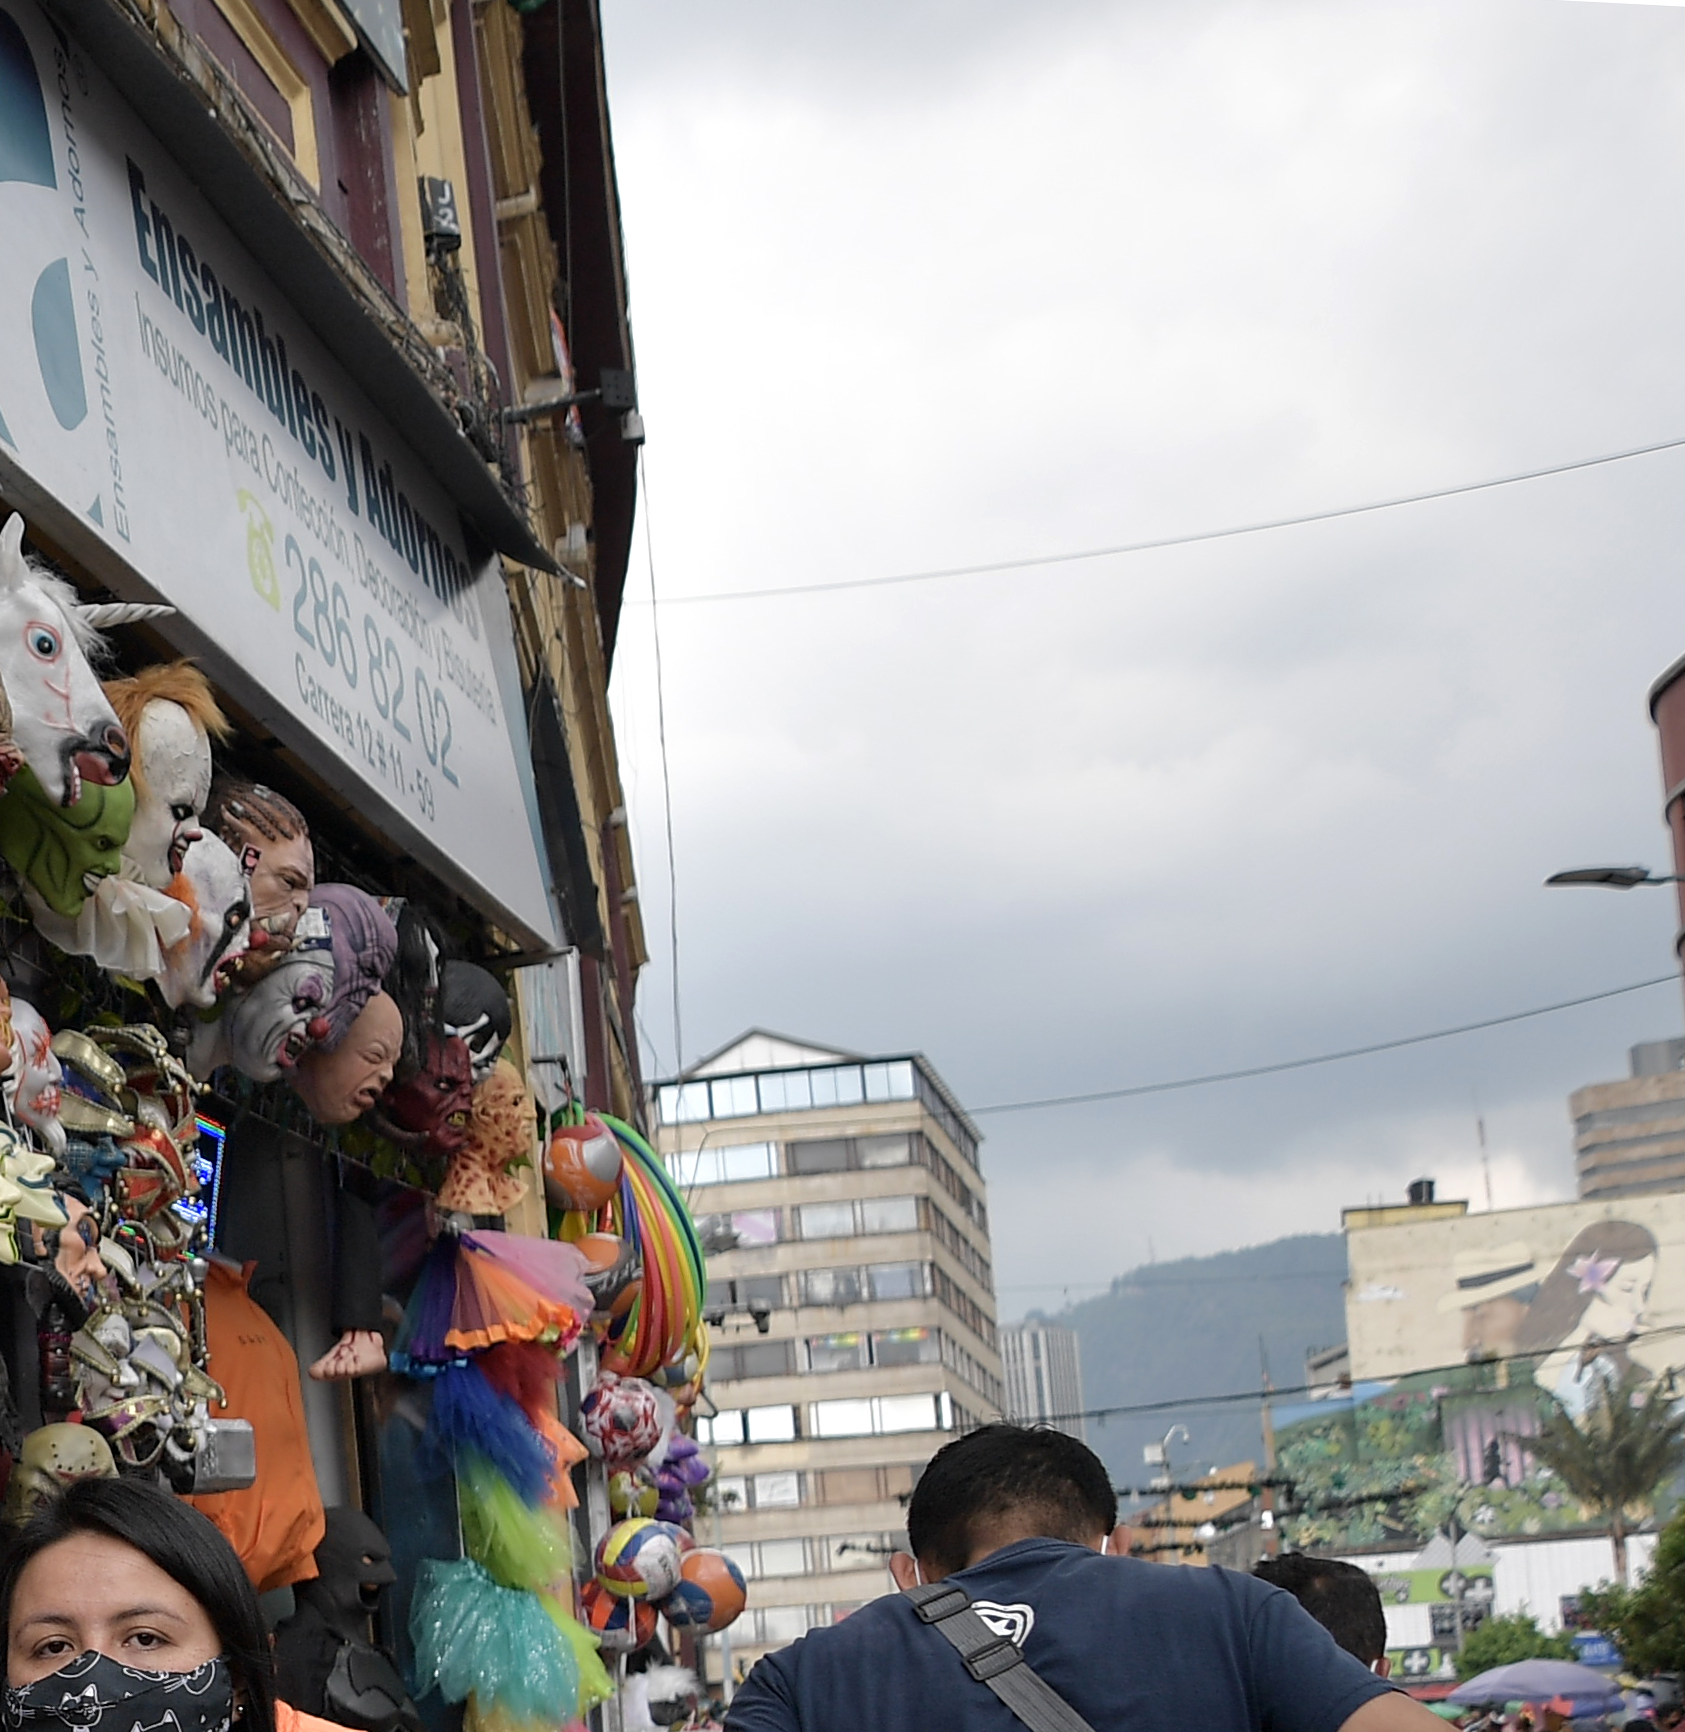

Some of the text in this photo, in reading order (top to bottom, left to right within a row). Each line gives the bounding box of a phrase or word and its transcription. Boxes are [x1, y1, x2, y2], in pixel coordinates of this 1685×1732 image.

[54, 46, 131, 544] Ensambles y Adornos
[126, 153, 480, 641] Ensambles y Adornos
[135, 290, 219, 431] Insumos
[221, 398, 262, 478] para
[285, 533, 459, 789] 286 82 02
[295, 652, 354, 748] Carrera
[356, 710, 375, 768] 12
[388, 742, 405, 796] 11
[416, 768, 435, 822] 59
